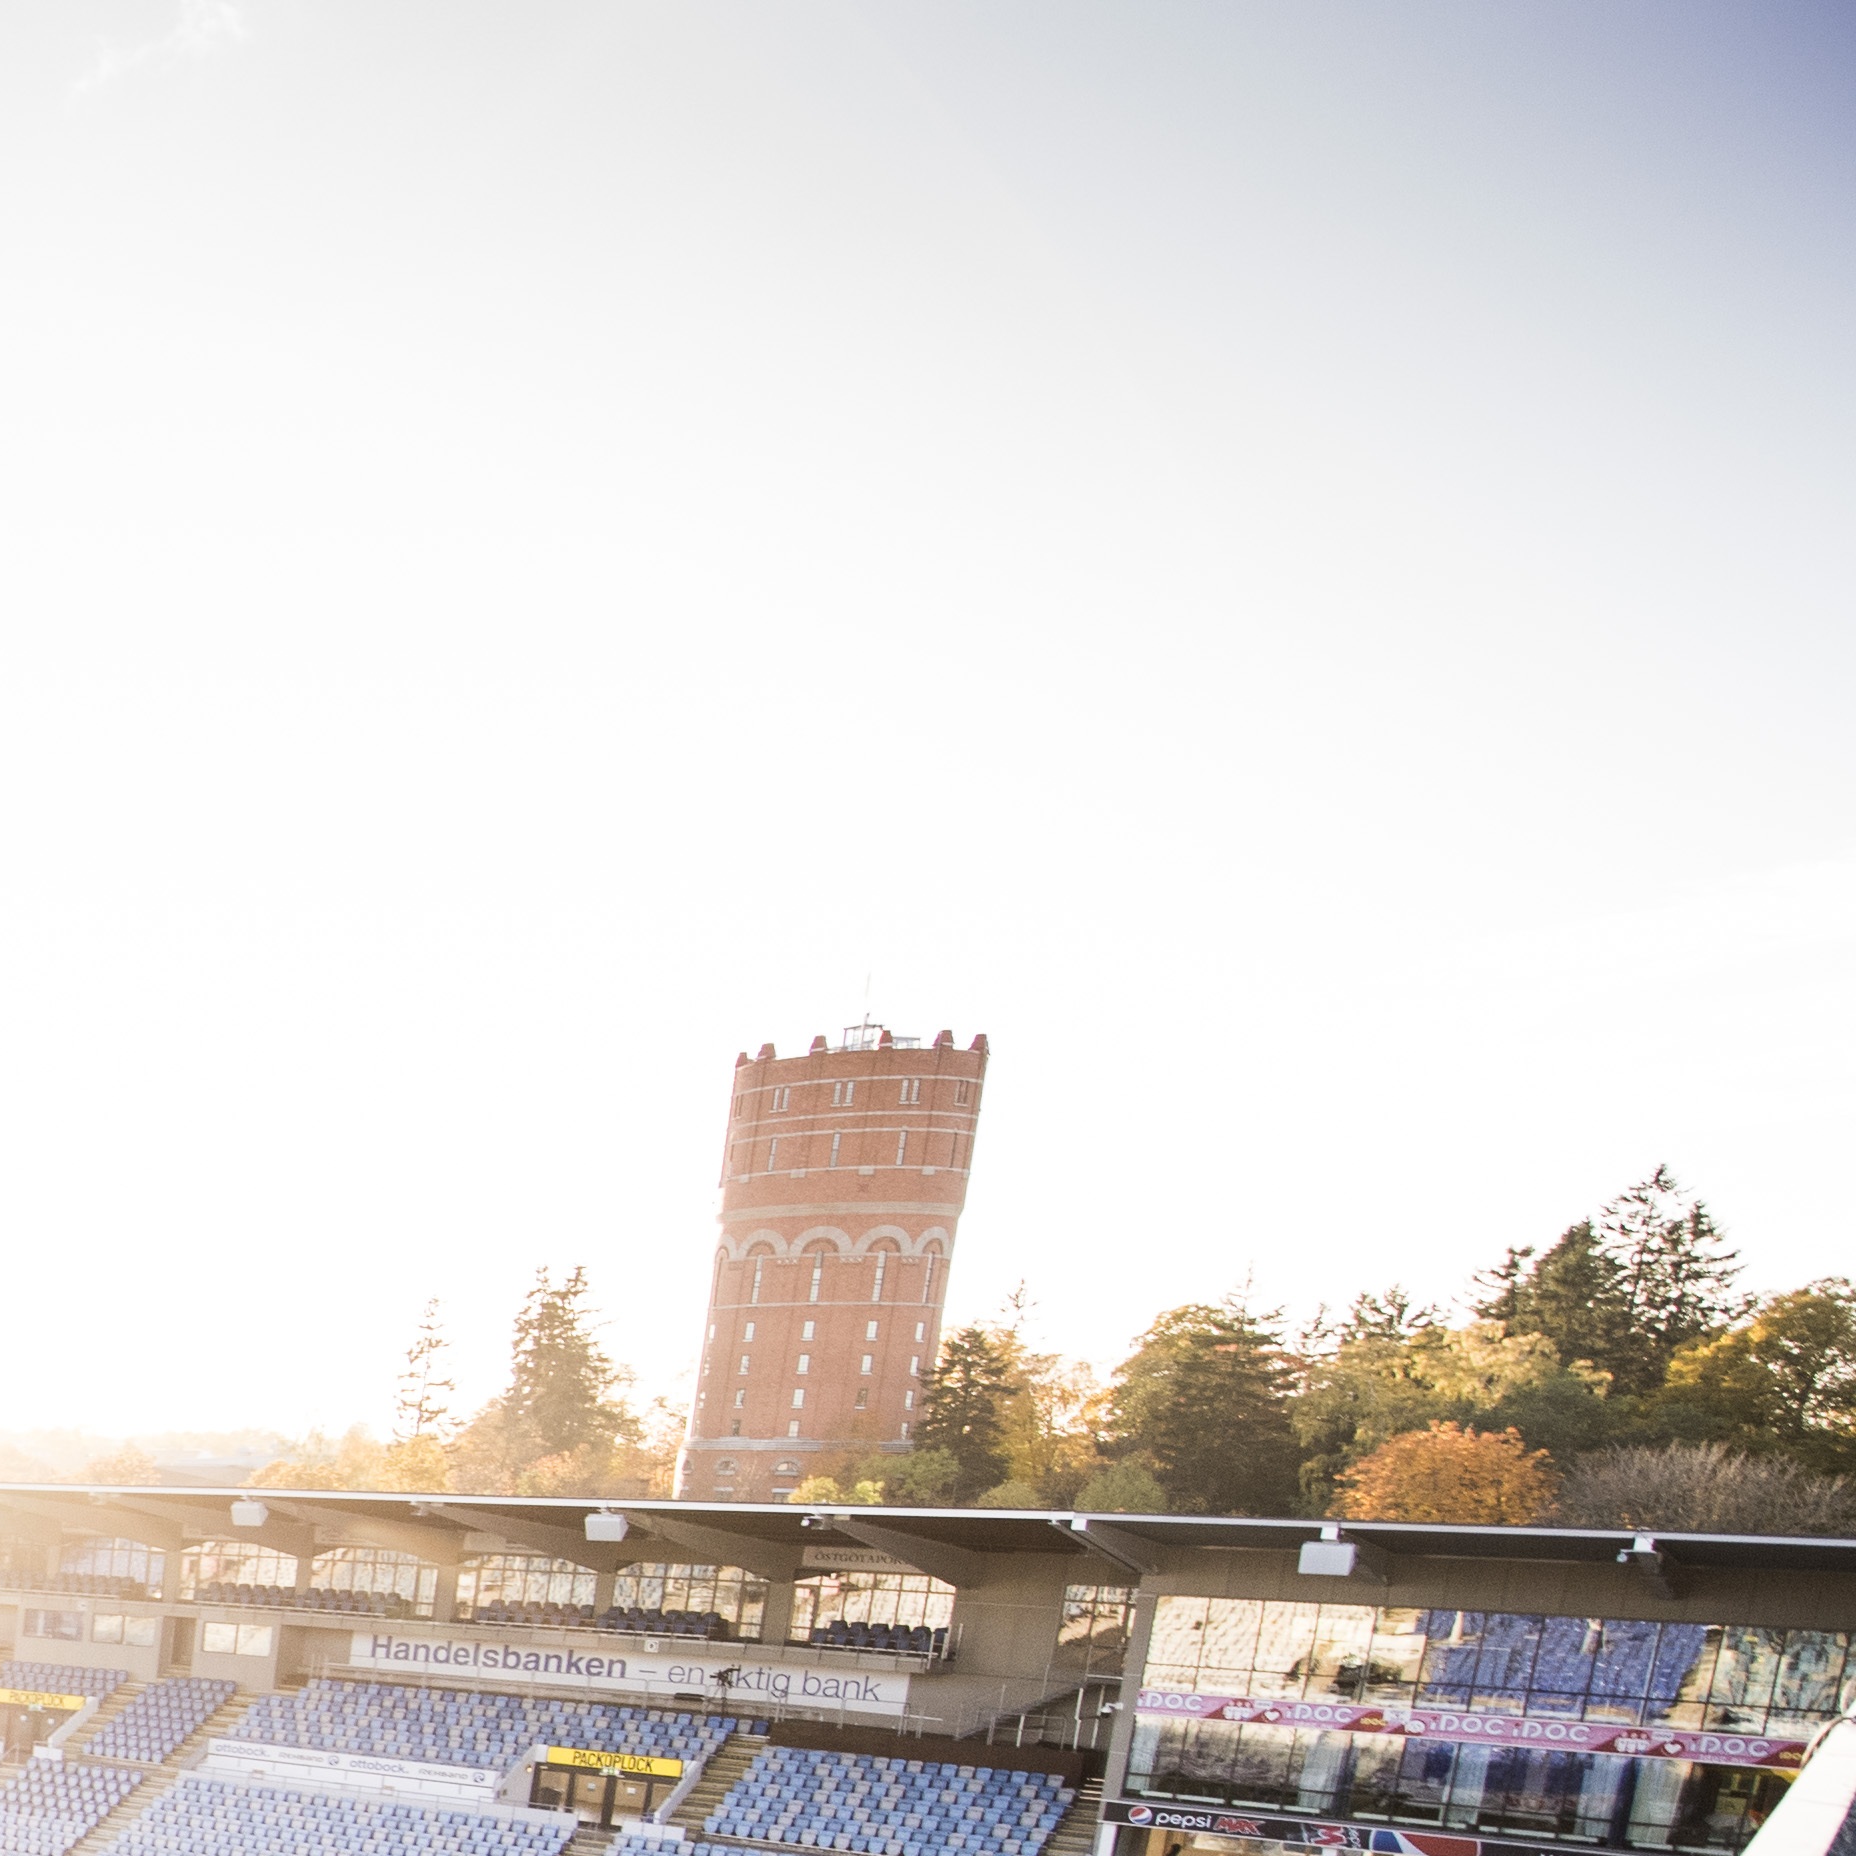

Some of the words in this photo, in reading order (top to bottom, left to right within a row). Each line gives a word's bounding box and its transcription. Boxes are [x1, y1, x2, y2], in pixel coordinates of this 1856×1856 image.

[371, 1635, 627, 1678] Handelsbanken
[668, 1665, 704, 1683] en
[717, 1665, 791, 1697] iktig
[803, 1670, 882, 1701] bank
[1430, 1715, 1505, 1735] iDOC
[1512, 1721, 1591, 1742] iDOC
[573, 1751, 655, 1772] PACKOPLOCK
[1155, 1811, 1212, 1828] pepsi
[1213, 1816, 1266, 1836] MAX
